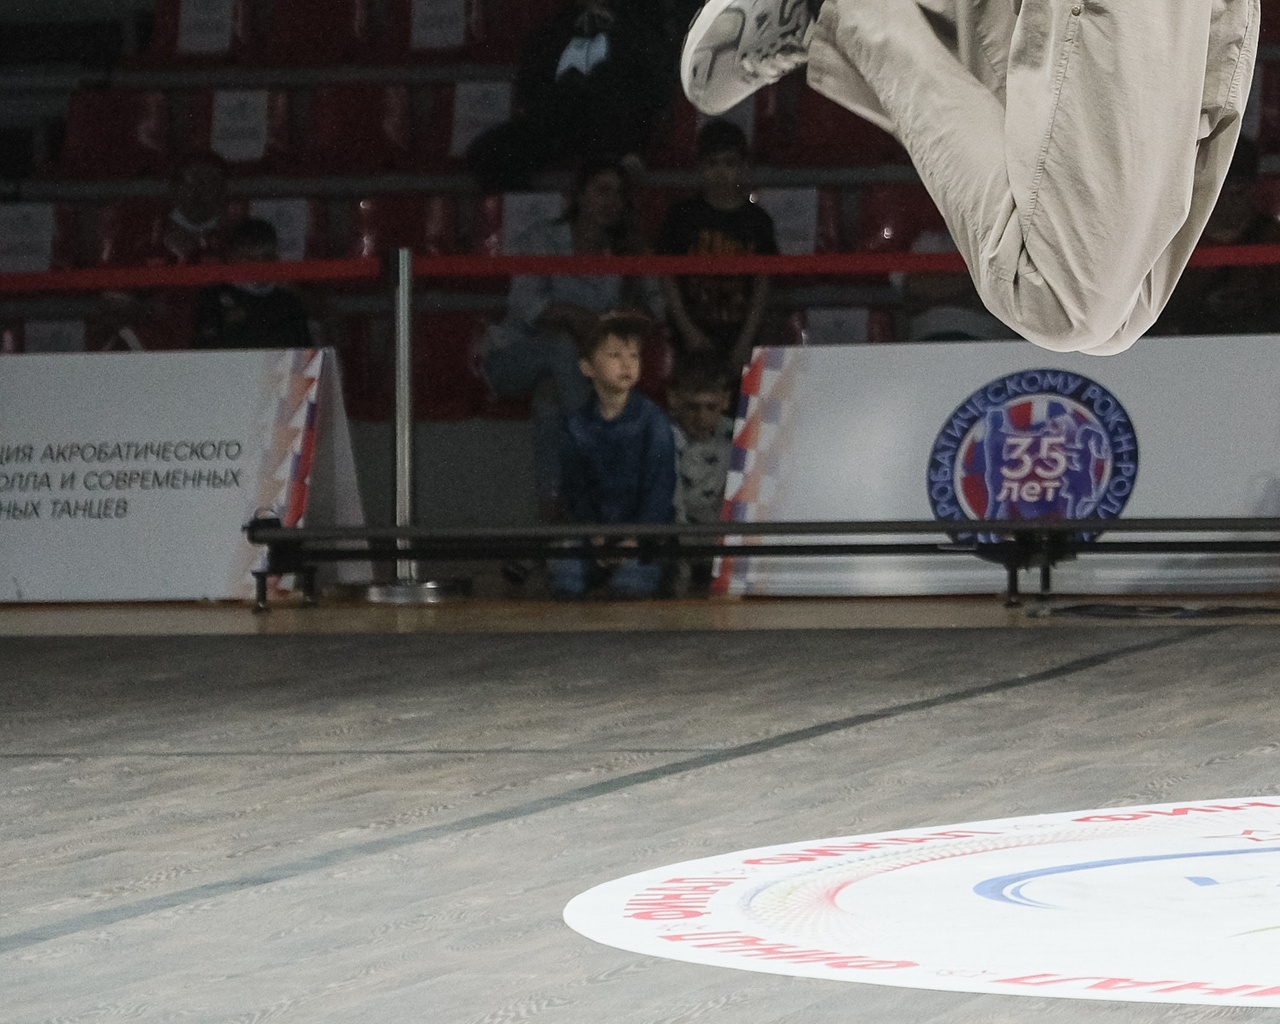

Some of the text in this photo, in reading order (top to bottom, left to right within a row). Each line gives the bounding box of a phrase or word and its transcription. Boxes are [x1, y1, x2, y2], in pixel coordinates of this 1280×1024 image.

[40, 439, 243, 463] АКРОБАТИЧЕСКОГО
[929, 372, 1138, 522] РОБАТИЧЕСКОМУ РОК-Н-РОЛ
[1001, 436, 1067, 480] 35
[60, 470, 76, 491] И
[83, 467, 242, 492] СОВРЕМЕННЫХ
[996, 478, 1063, 503] лет
[51, 496, 129, 521] ТАНЦЕВ
